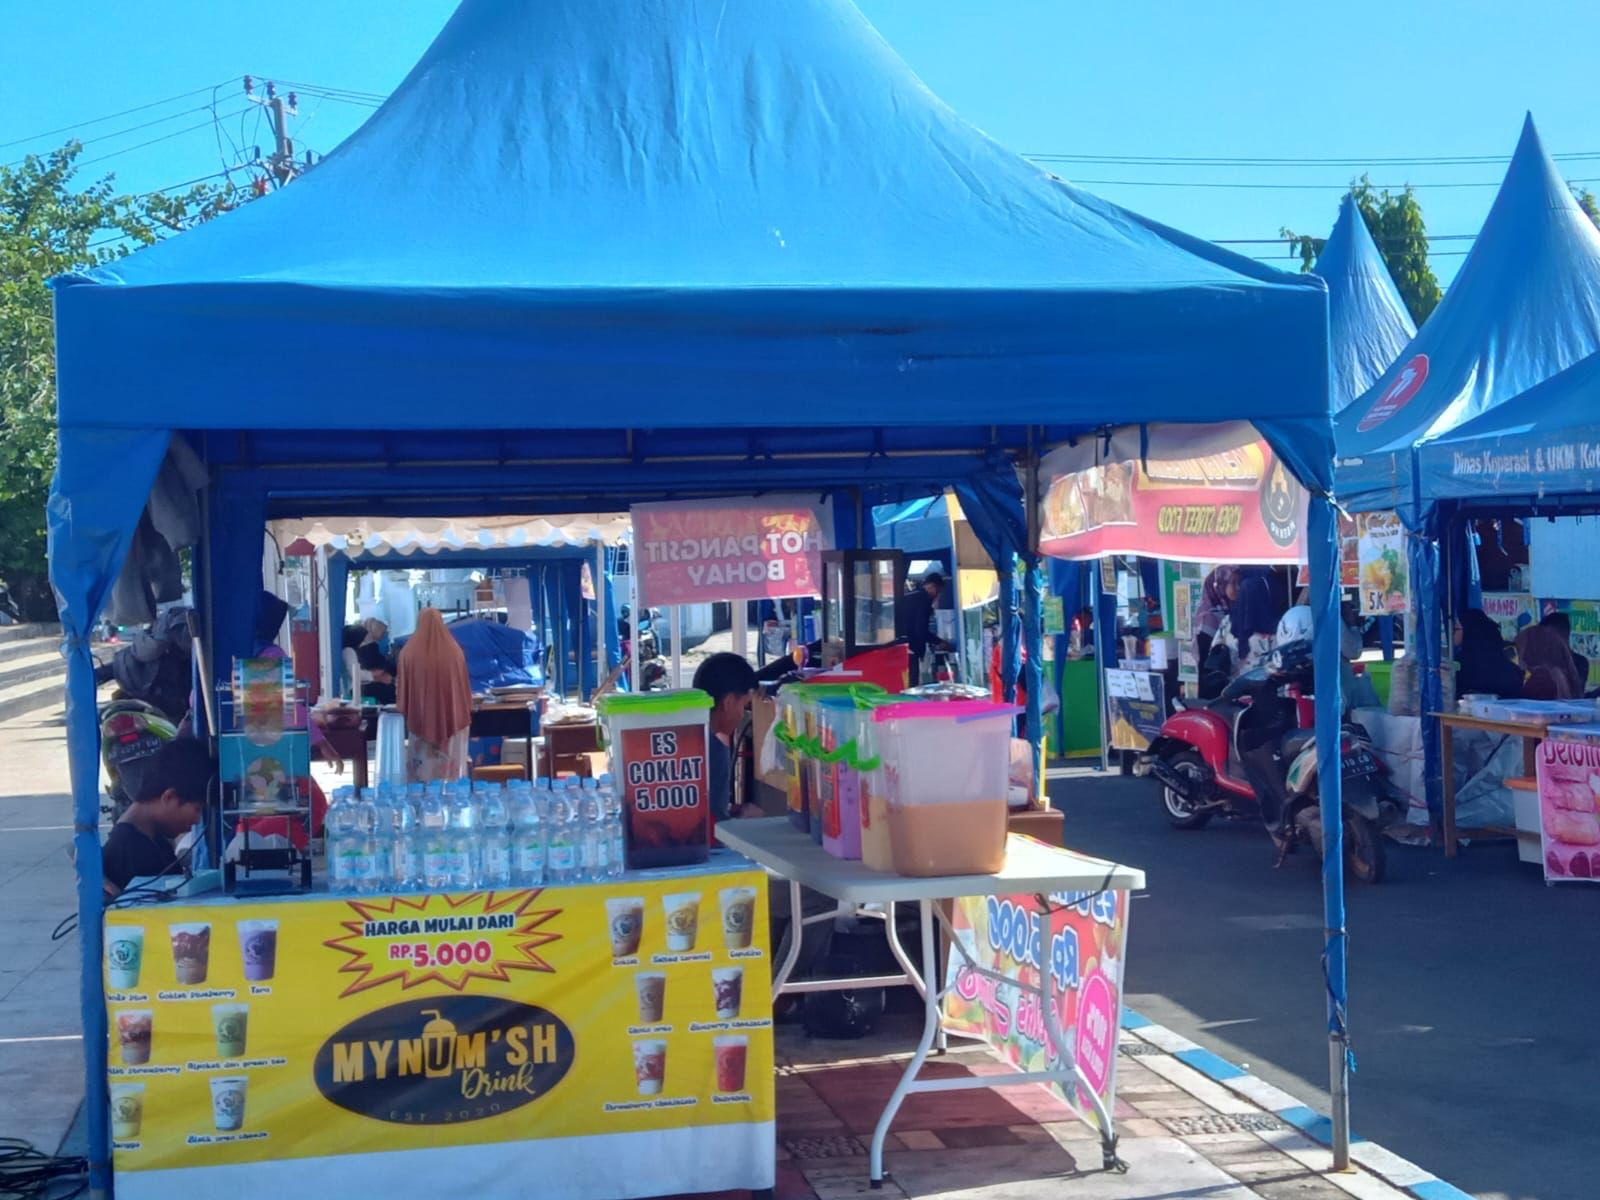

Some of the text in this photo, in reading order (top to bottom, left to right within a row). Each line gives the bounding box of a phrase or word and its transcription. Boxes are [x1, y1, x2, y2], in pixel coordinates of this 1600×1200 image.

[1453, 450, 1481, 475] Dinas
[1536, 448, 1545, 473] &
[1547, 444, 1575, 471] UKM
[1369, 592, 1384, 610] 5K
[651, 731, 677, 756] ES
[629, 756, 703, 785] COKLAT
[636, 785, 699, 811] 5.000
[364, 914, 515, 937] HARGA MULAI DARI
[332, 1023, 558, 1084] MYNUM'SH
[461, 1061, 536, 1100] Drink
